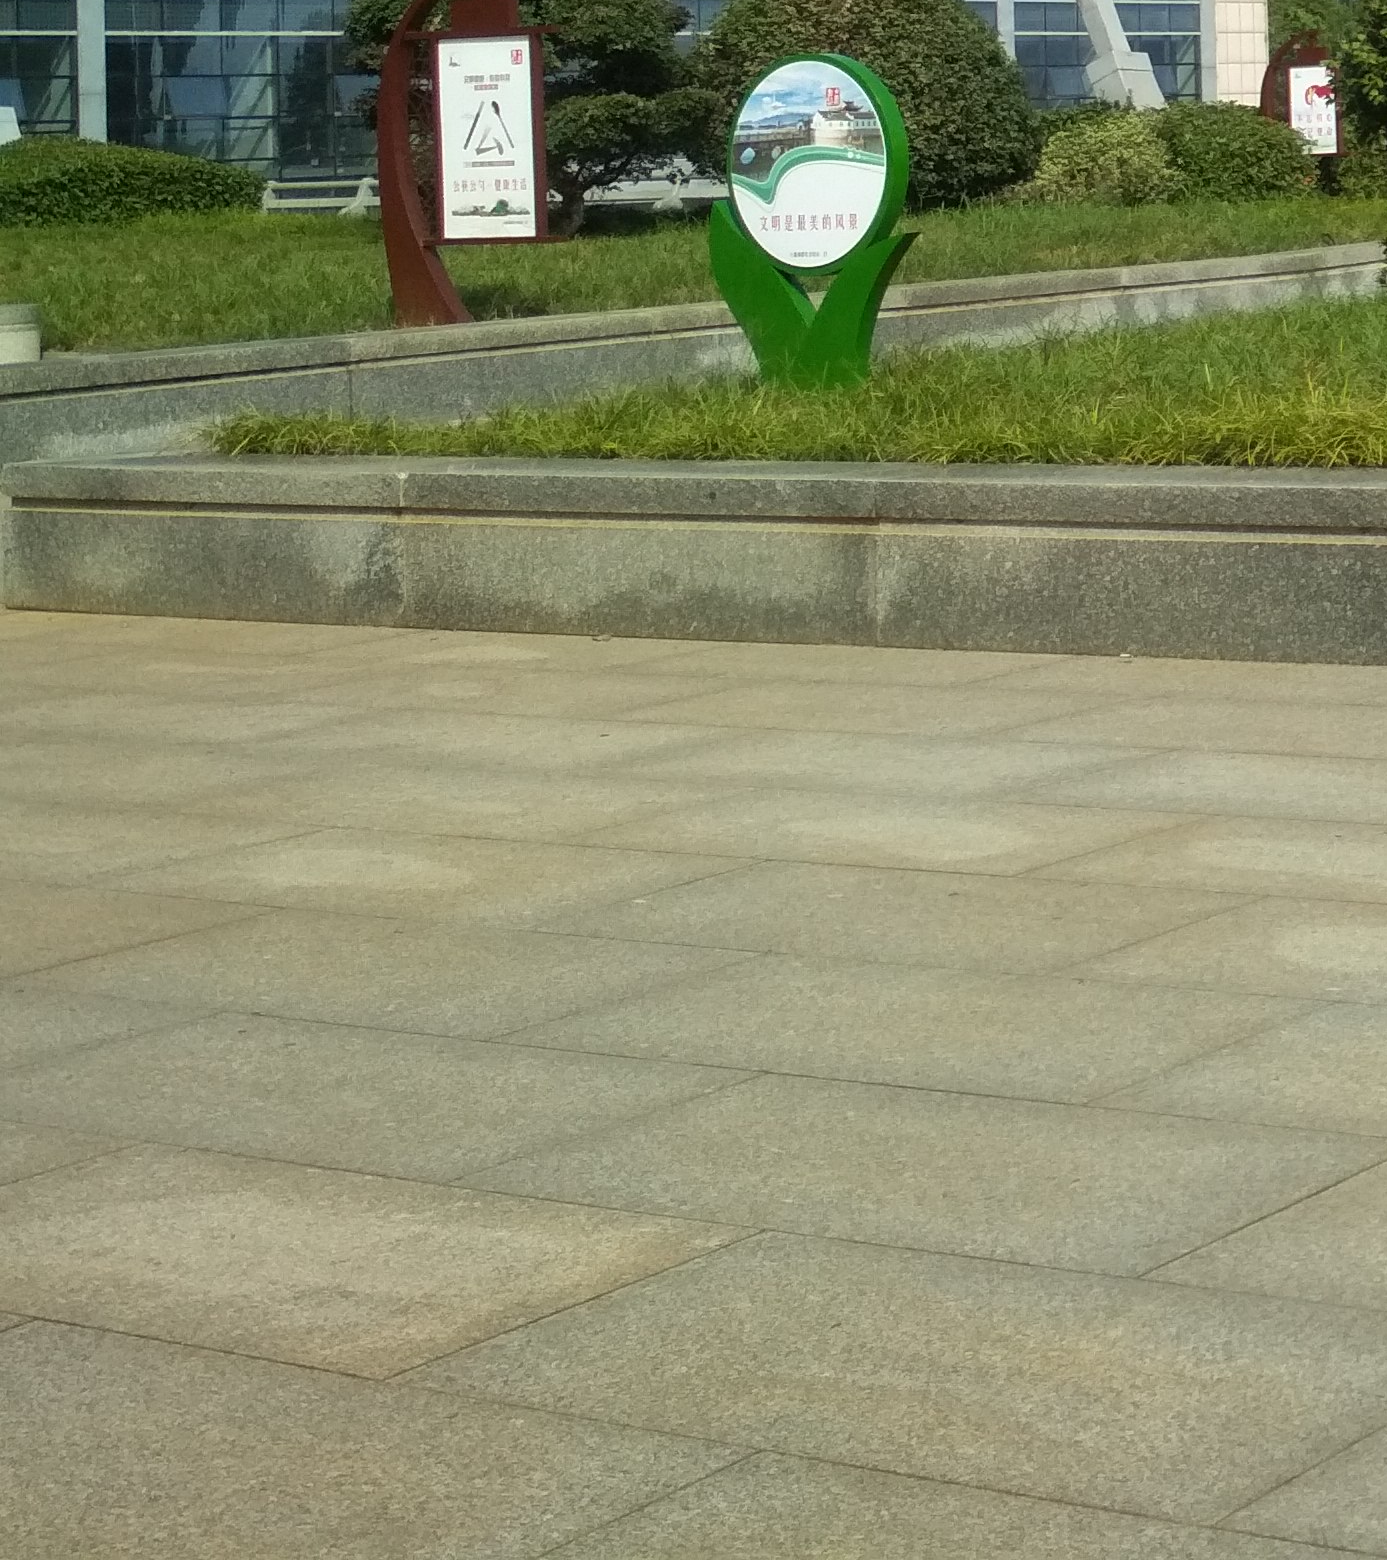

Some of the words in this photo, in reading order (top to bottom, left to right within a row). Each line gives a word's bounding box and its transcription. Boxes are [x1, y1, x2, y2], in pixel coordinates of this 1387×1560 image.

[760, 213, 859, 232] 文明是最美的风景
